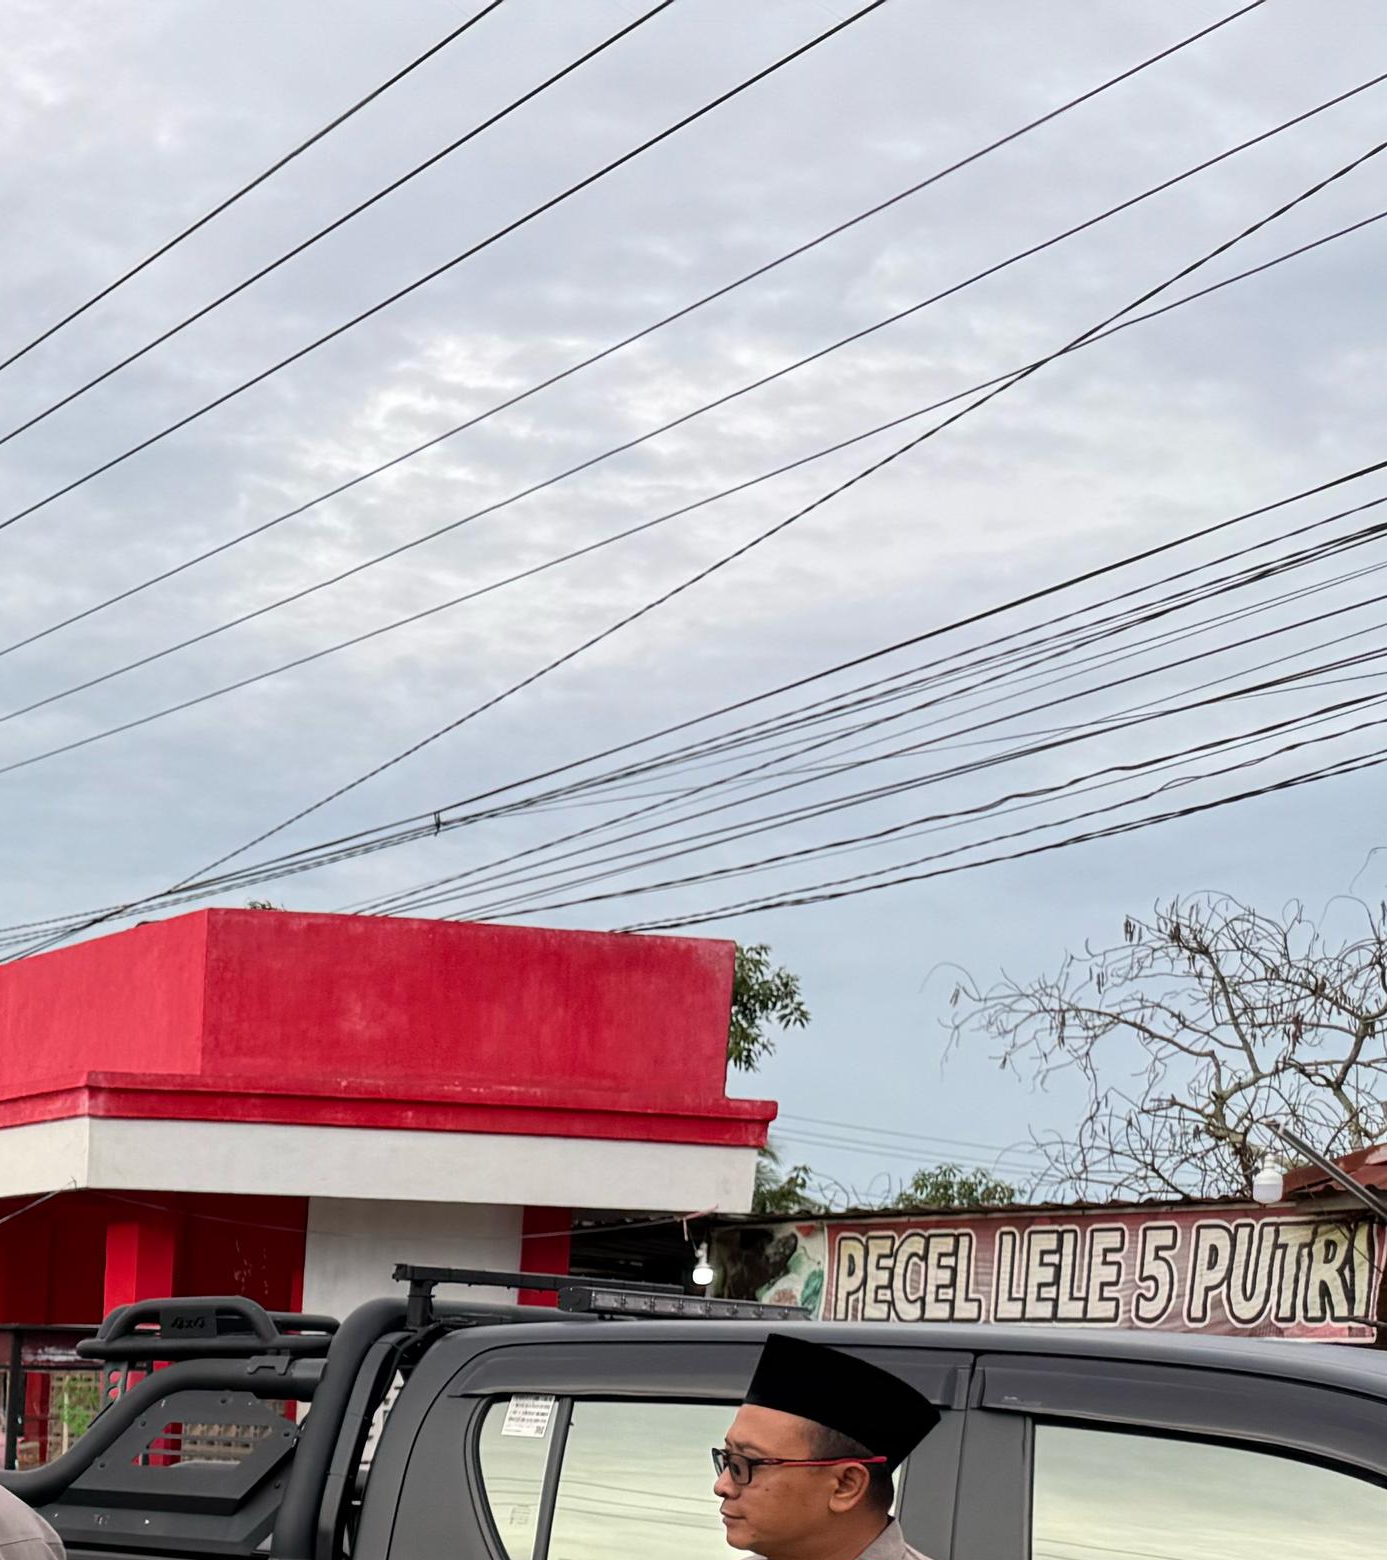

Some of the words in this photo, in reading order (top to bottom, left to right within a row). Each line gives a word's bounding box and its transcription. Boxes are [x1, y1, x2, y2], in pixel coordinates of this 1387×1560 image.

[835, 1228, 981, 1322] PECEL
[994, 1225, 1125, 1323] LELE
[1134, 1223, 1178, 1323] 5
[1187, 1218, 1373, 1325] PUTRI
